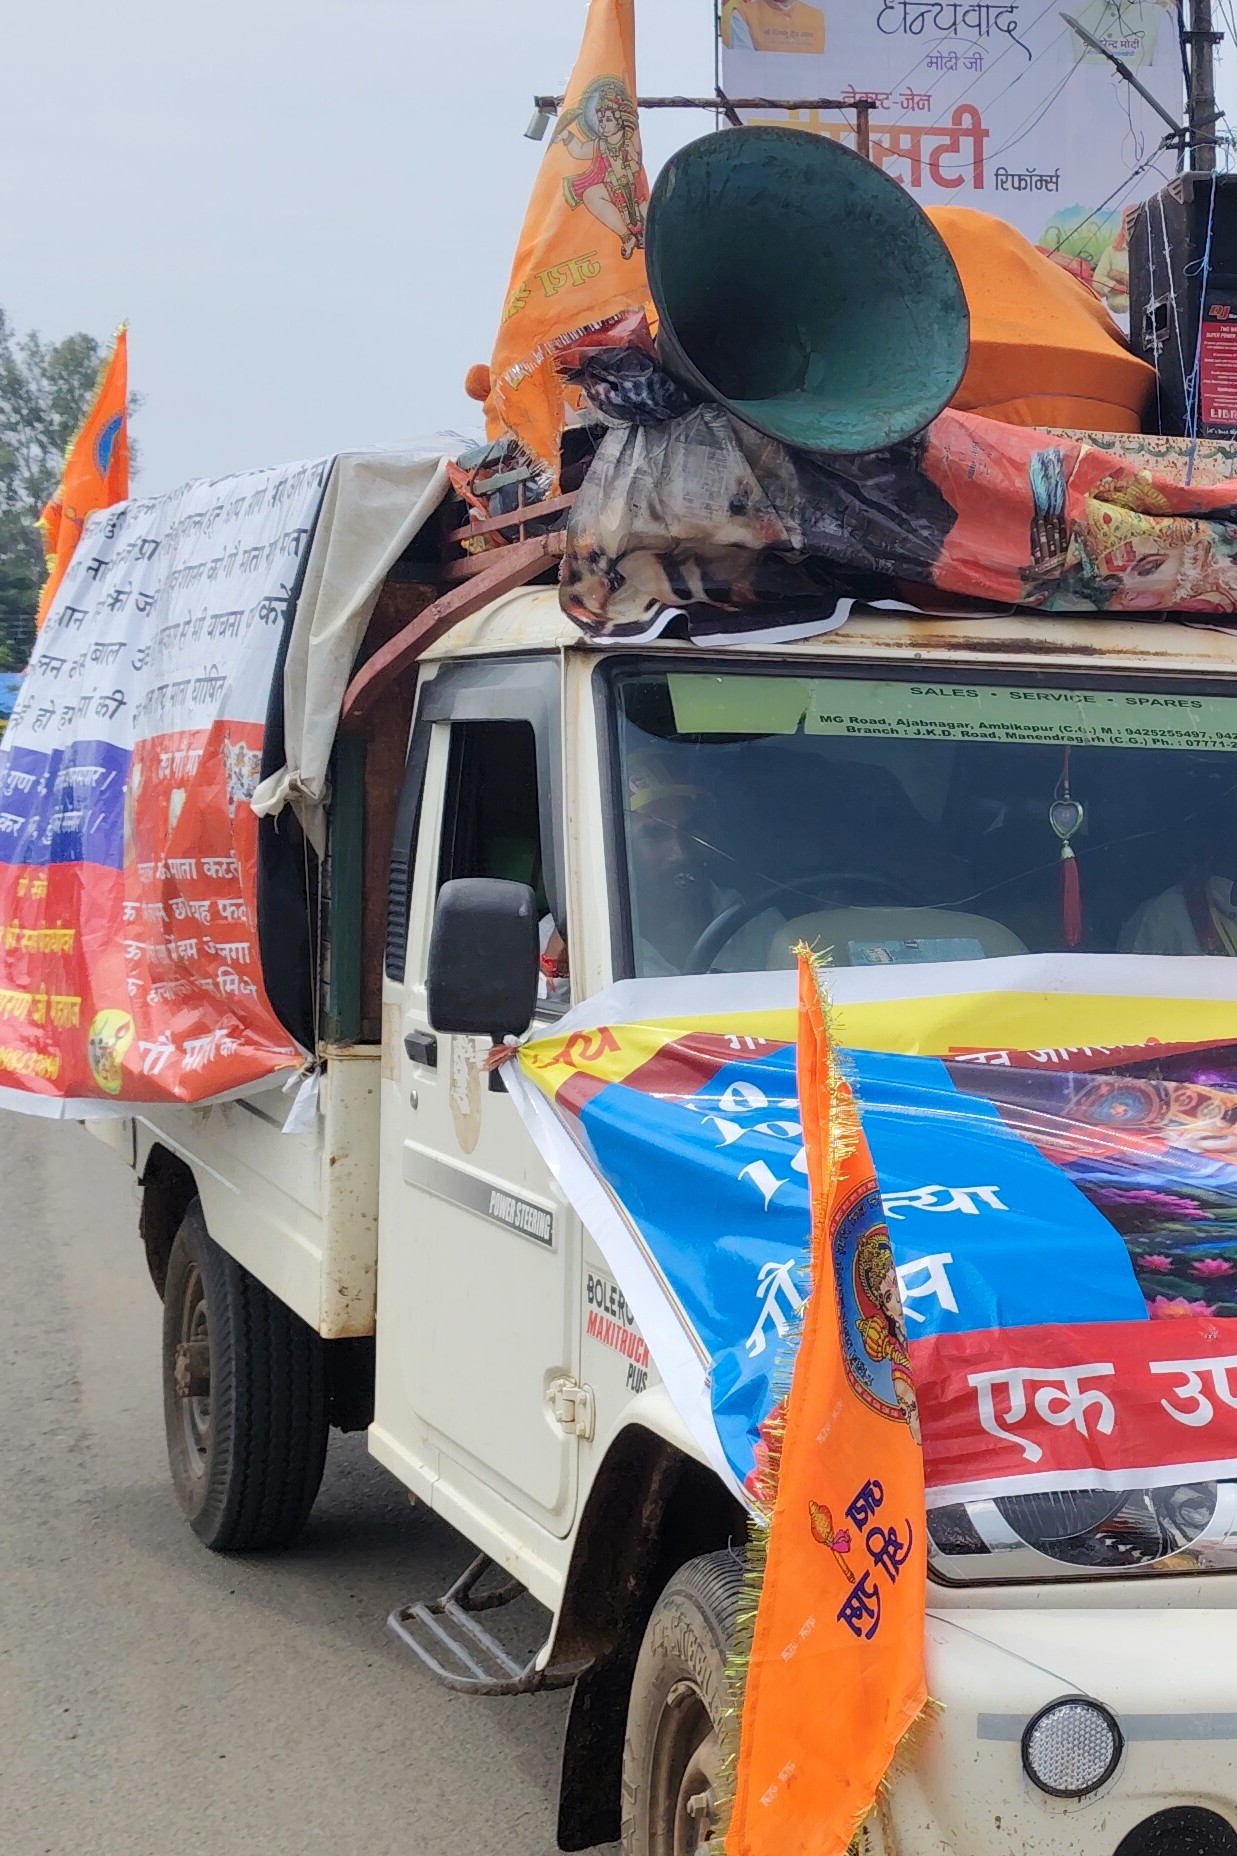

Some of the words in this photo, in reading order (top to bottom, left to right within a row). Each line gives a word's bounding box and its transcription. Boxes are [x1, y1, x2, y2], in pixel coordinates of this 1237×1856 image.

[876, 0, 1032, 61] धन्यवाद
[927, 50, 958, 71] मोदी
[963, 51, 984, 72] जी
[994, 167, 1060, 193] रिफॉर्म्स
[910, 687, 979, 698] SALES
[1010, 691, 1097, 704] SERVICE
[1126, 697, 1203, 709] SPARES
[820, 715, 843, 723] MG
[849, 716, 892, 726] Road,
[896, 718, 974, 730] Ajabnagar,
[978, 721, 1054, 732] Ambikapur
[846, 726, 899, 735] Branch
[913, 729, 956, 738] J.K.D.
[961, 730, 1001, 740] Road,
[489, 1190, 516, 1226] POWER
[514, 1200, 552, 1240] STEERING
[586, 1309, 649, 1369] MAXITRUCK
[625, 1362, 648, 1394] PLUS
[967, 1362, 1115, 1464] एक
